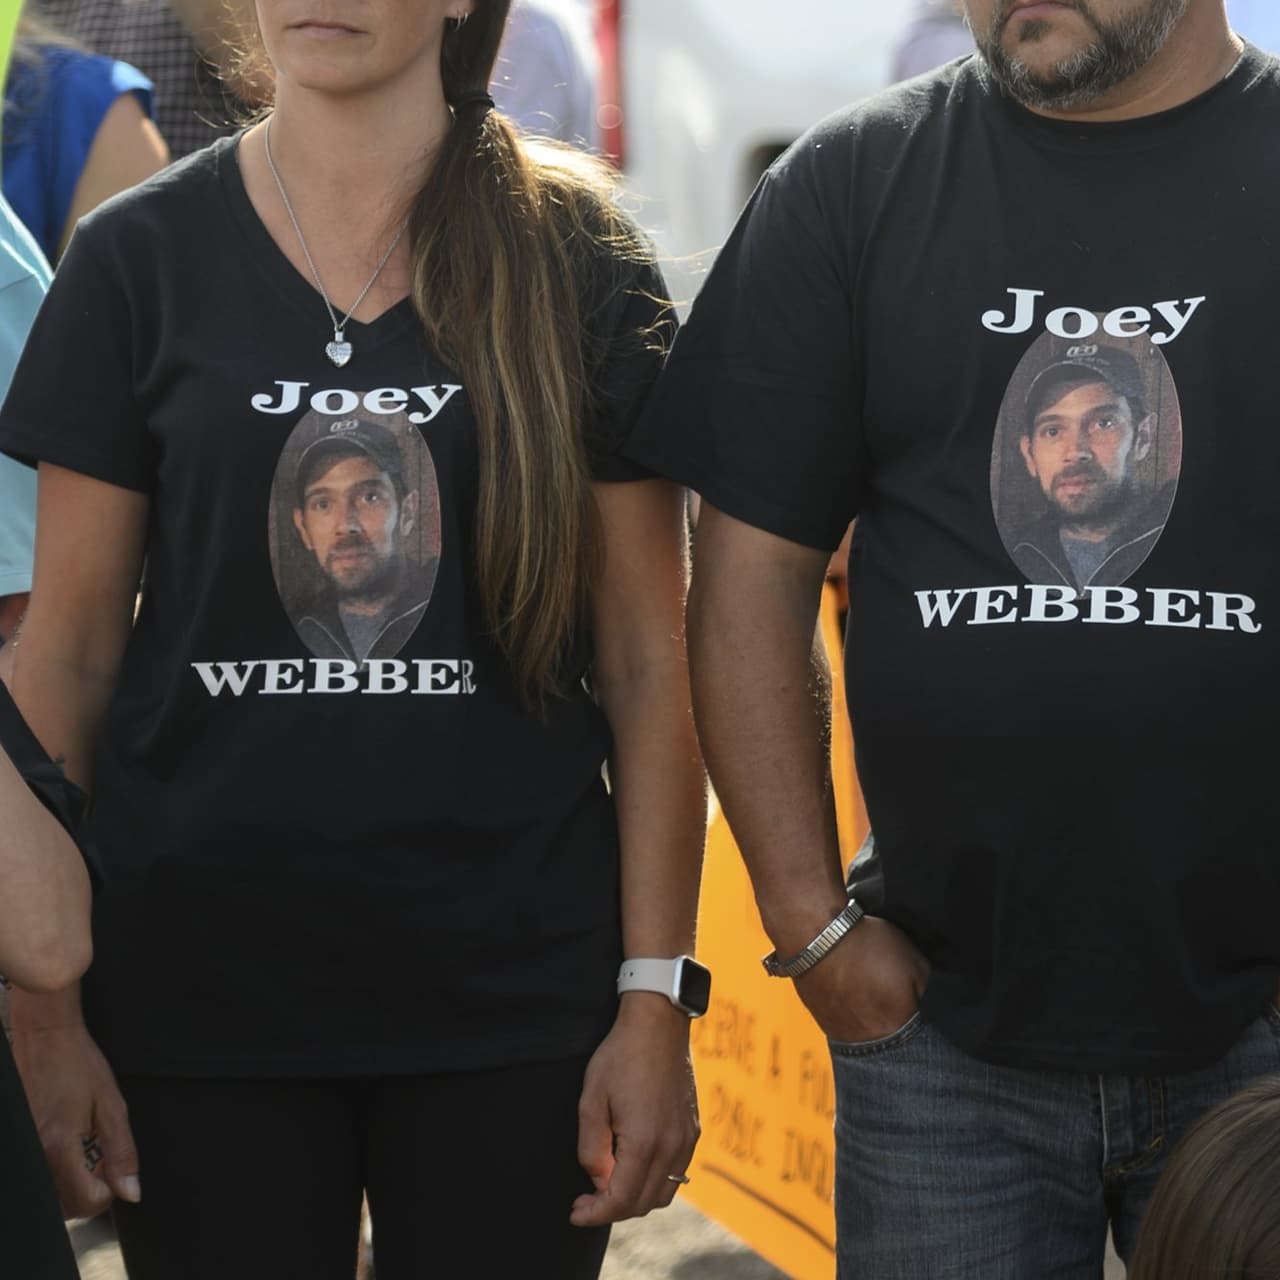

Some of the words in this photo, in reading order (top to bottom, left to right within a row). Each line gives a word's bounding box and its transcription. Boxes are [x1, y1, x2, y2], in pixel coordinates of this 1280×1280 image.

[981, 287, 1206, 345] Joey
[250, 380, 463, 424] Joey
[914, 583, 1263, 634] WEBBER
[191, 657, 477, 698] WEBBER
